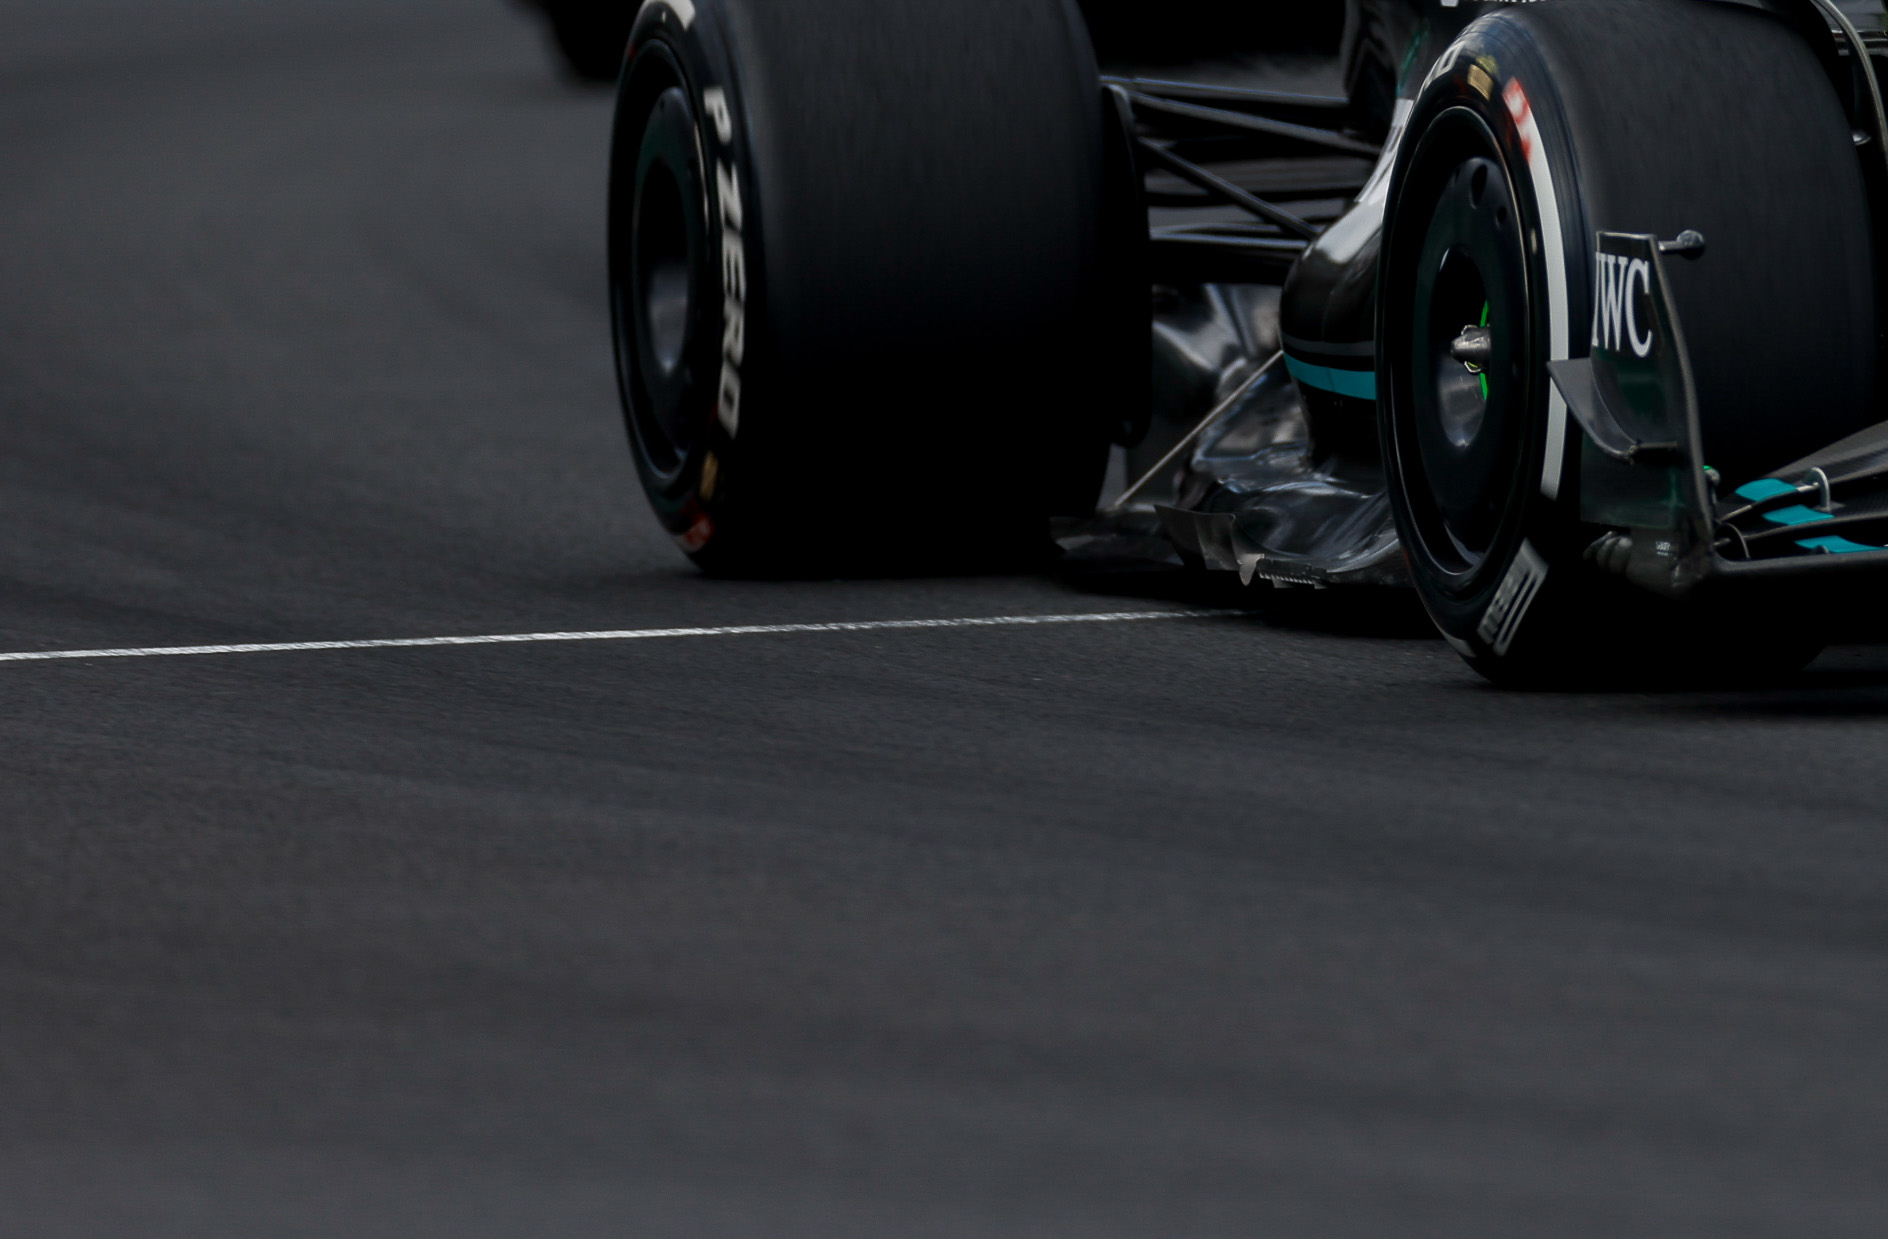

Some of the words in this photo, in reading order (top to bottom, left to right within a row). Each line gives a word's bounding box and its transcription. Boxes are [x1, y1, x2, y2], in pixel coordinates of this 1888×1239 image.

[703, 87, 732, 145] P
[716, 160, 745, 438] ZERO
[1591, 251, 1653, 358] IWC
